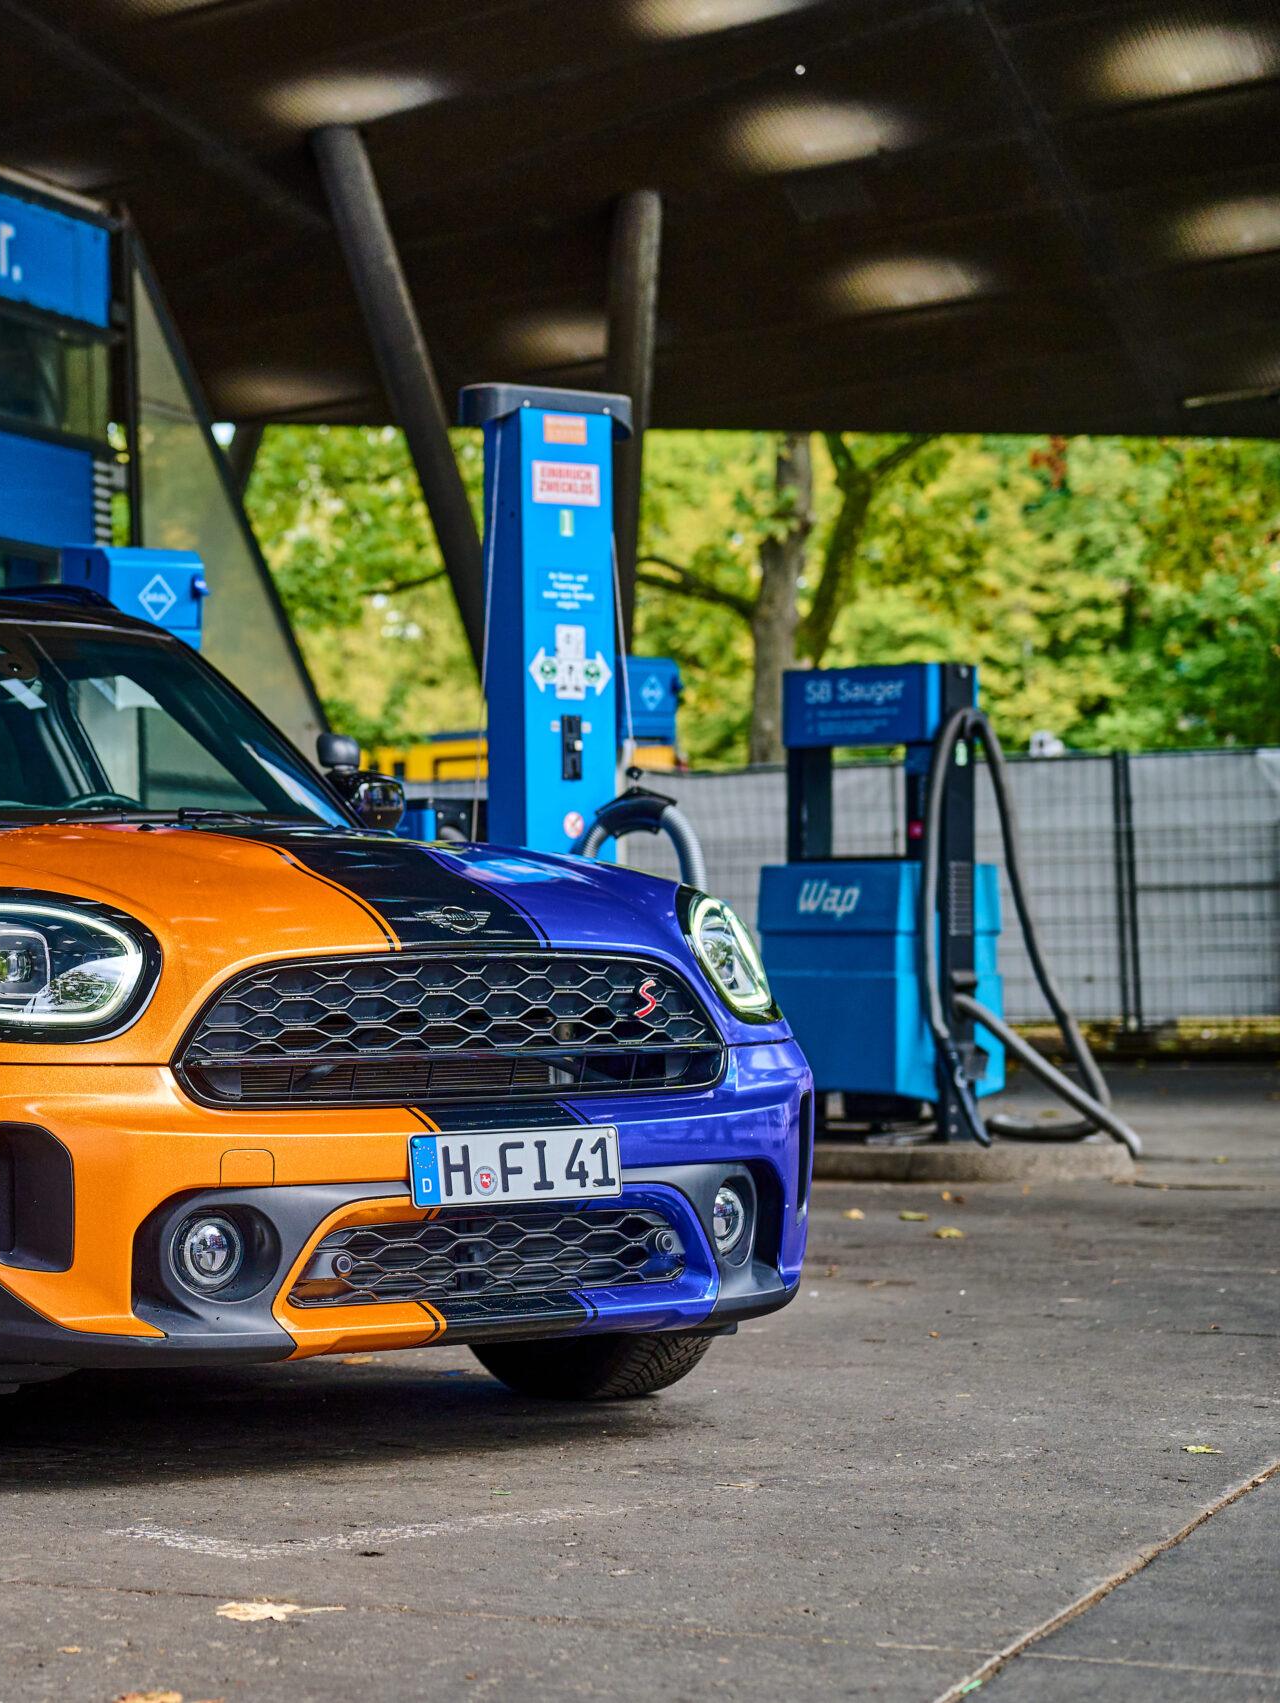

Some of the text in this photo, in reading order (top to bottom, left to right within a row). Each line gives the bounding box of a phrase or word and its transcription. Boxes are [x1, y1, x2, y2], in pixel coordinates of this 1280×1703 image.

[539, 480, 593, 496] ZWECKLOS
[540, 466, 593, 480] EINBRUCH
[805, 678, 904, 705] SB Sauger
[798, 880, 860, 920] Wap
[634, 979, 656, 1018] S
[422, 1178, 433, 1193] D
[442, 1144, 472, 1197] H
[565, 1137, 616, 1188] 41
